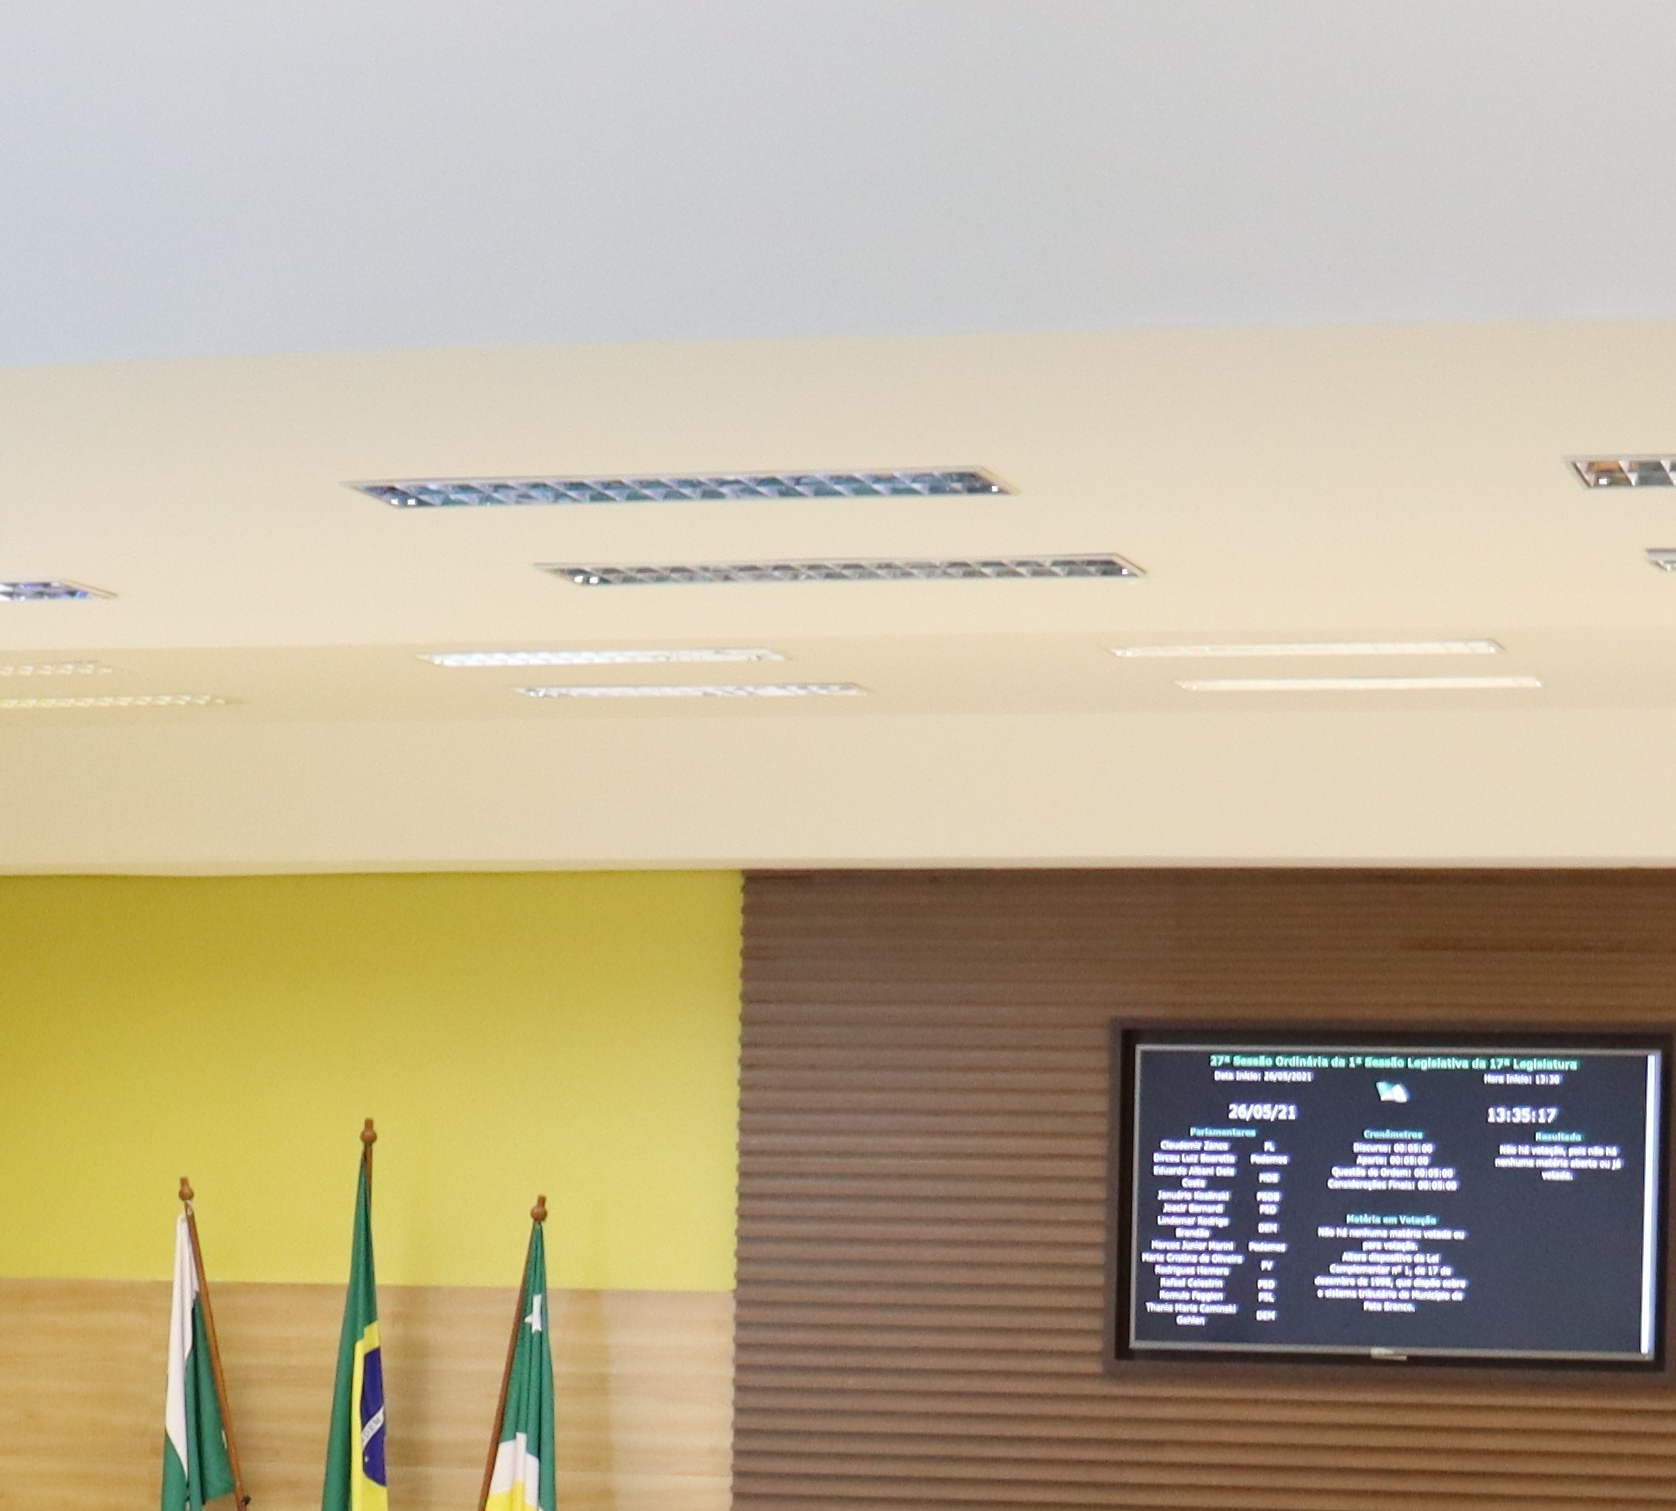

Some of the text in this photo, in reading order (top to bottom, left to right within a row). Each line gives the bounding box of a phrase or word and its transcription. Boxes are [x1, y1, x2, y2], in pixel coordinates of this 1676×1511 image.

[1233, 1055, 1272, 1067] Sessão
[1275, 1056, 1328, 1067] Ordinária
[1331, 1057, 1345, 1068] da
[1365, 1057, 1404, 1068] Sessão
[1408, 1057, 1468, 1070] Legislativa
[1472, 1059, 1486, 1069] da
[1513, 1059, 1577, 1071] Legislatura
[1214, 1071, 1234, 1081] Data
[1484, 1074, 1504, 1084] Hora
[1229, 1104, 1296, 1121] 26/05/21
[1488, 1107, 1557, 1123] 13:35:17
[1190, 1128, 1256, 1137] Parlamentares
[1364, 1129, 1424, 1140] Cronômetros
[1535, 1132, 1582, 1142] Resultado
[1399, 1215, 1437, 1226] Votação
